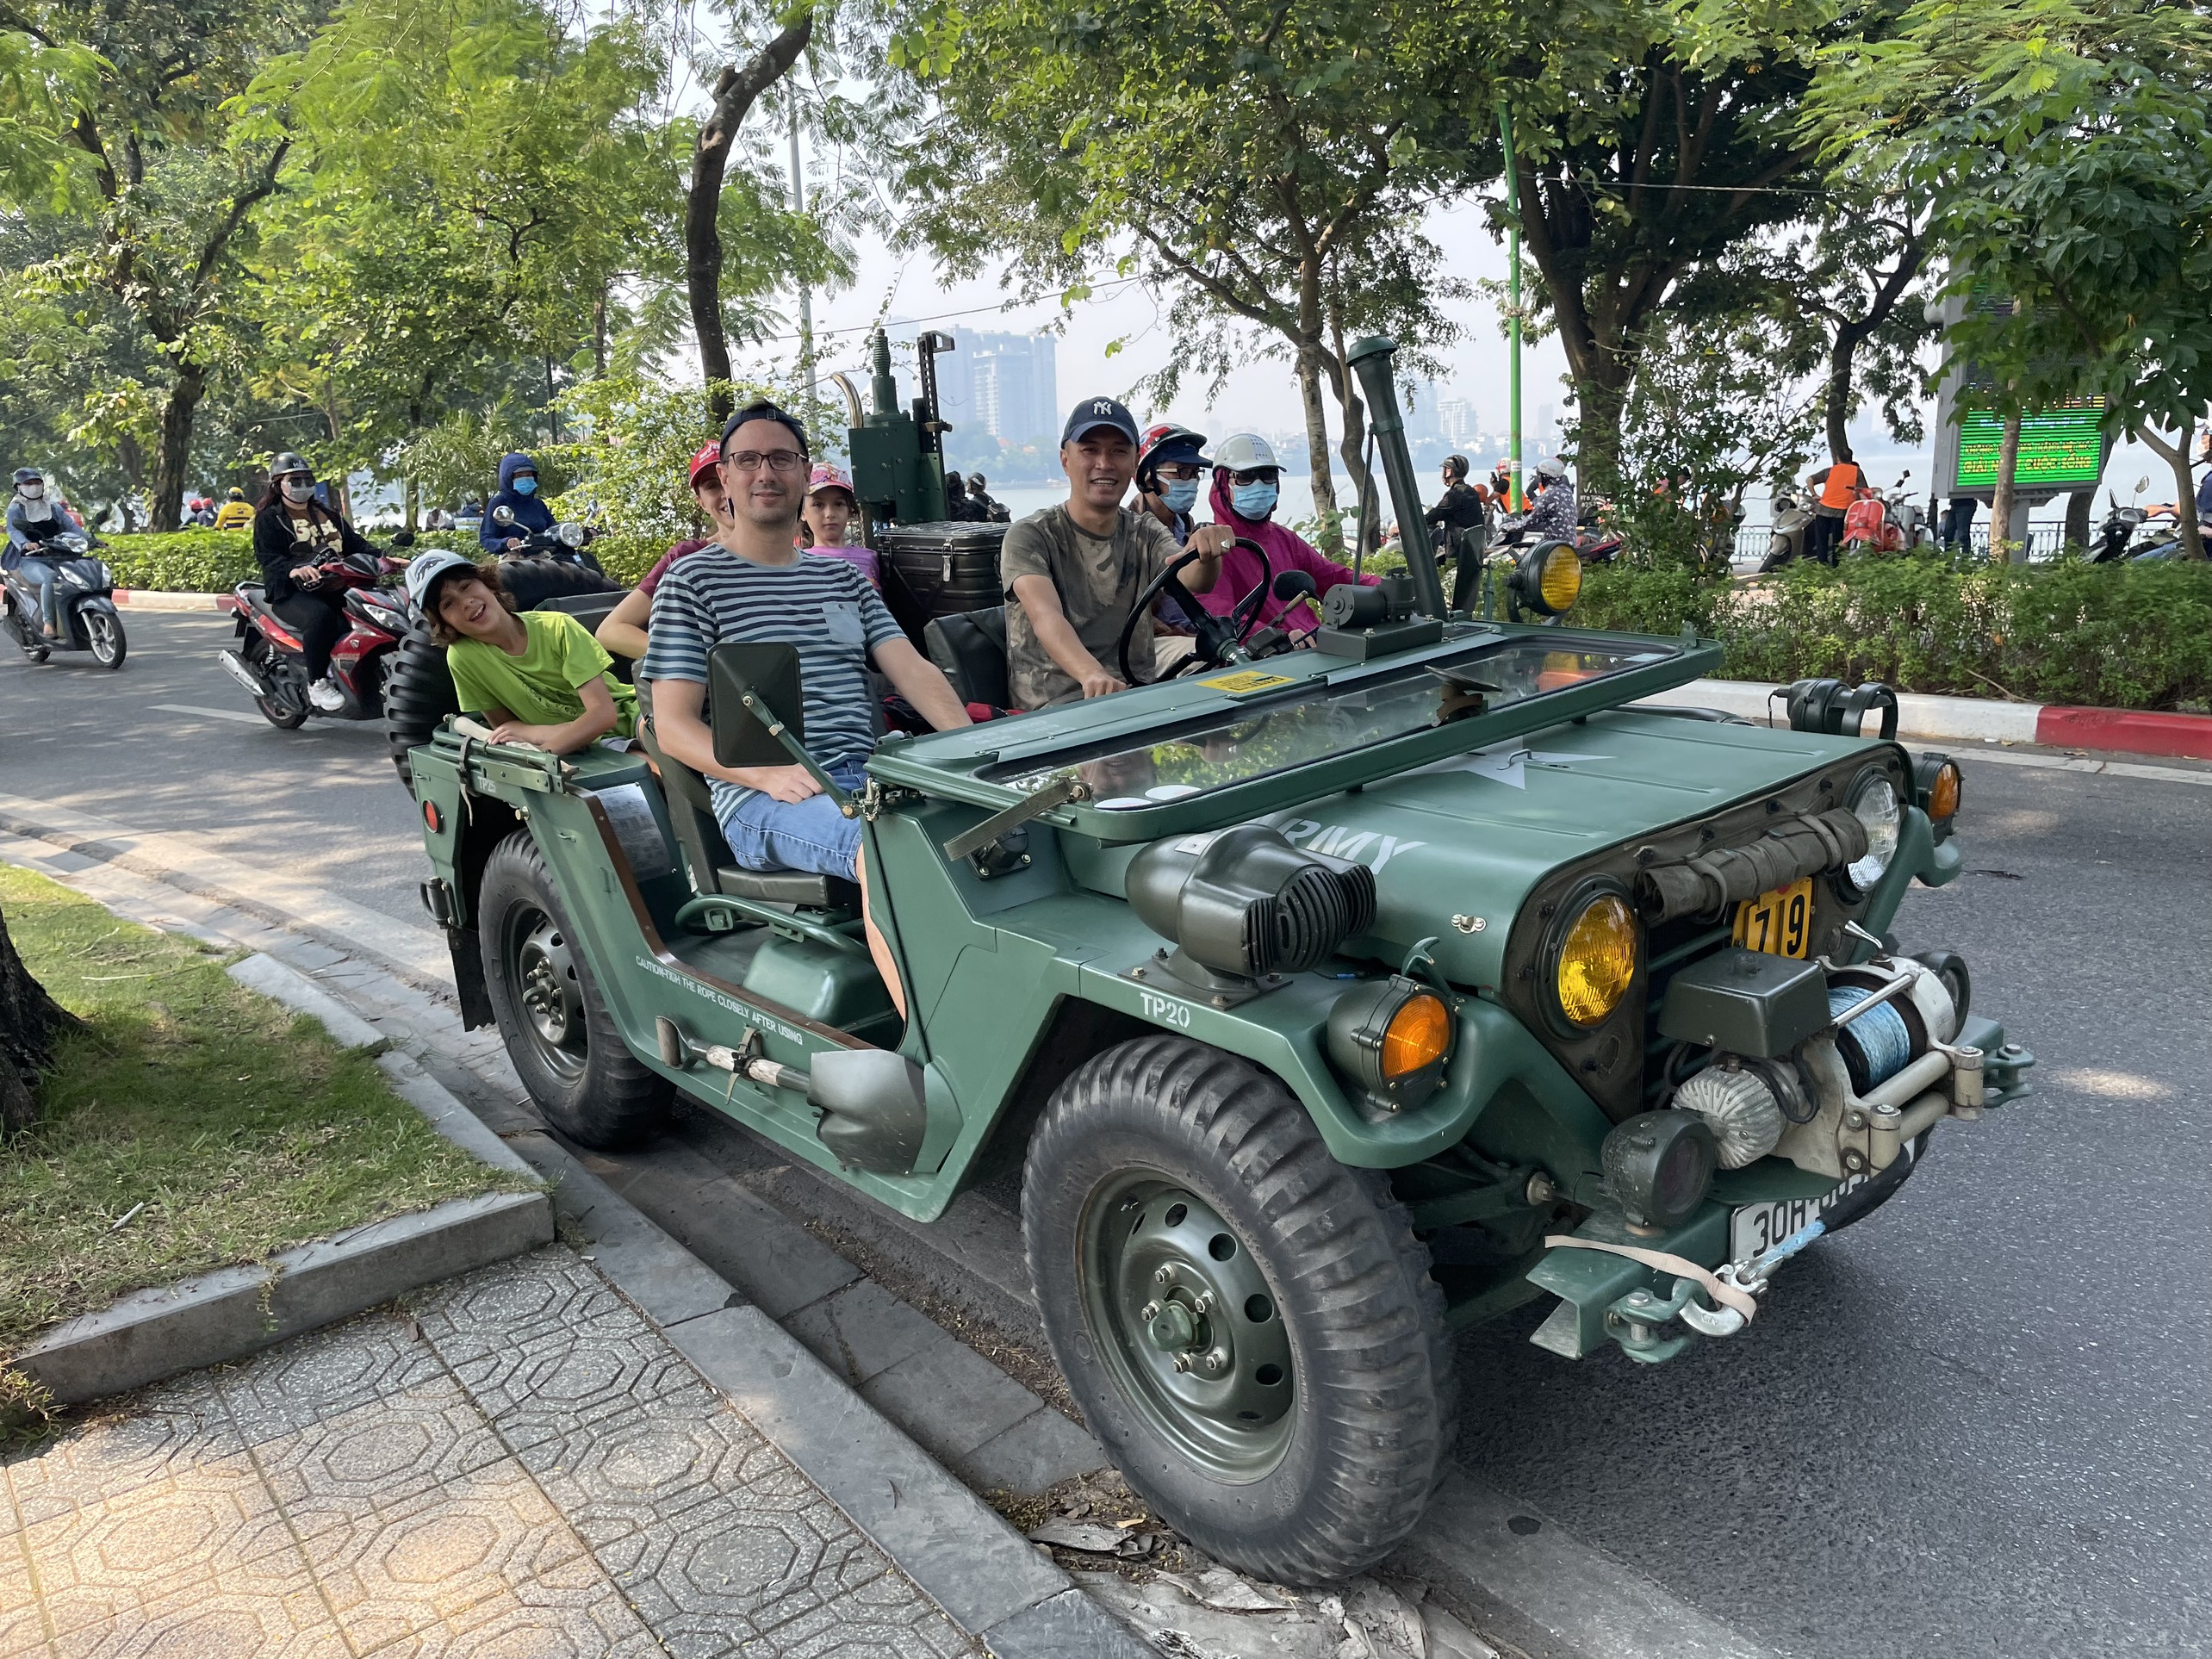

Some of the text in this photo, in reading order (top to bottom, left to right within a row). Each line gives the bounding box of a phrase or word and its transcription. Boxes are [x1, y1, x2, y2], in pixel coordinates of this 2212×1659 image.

[1239, 813, 1429, 875] RMY
[681, 976, 697, 993] THE
[696, 984, 718, 1003] ROPE
[717, 994, 749, 1019] CLOSELY
[751, 1010, 777, 1033] AFTER
[777, 1022, 804, 1046] USING
[1140, 991, 1190, 1028] TP20
